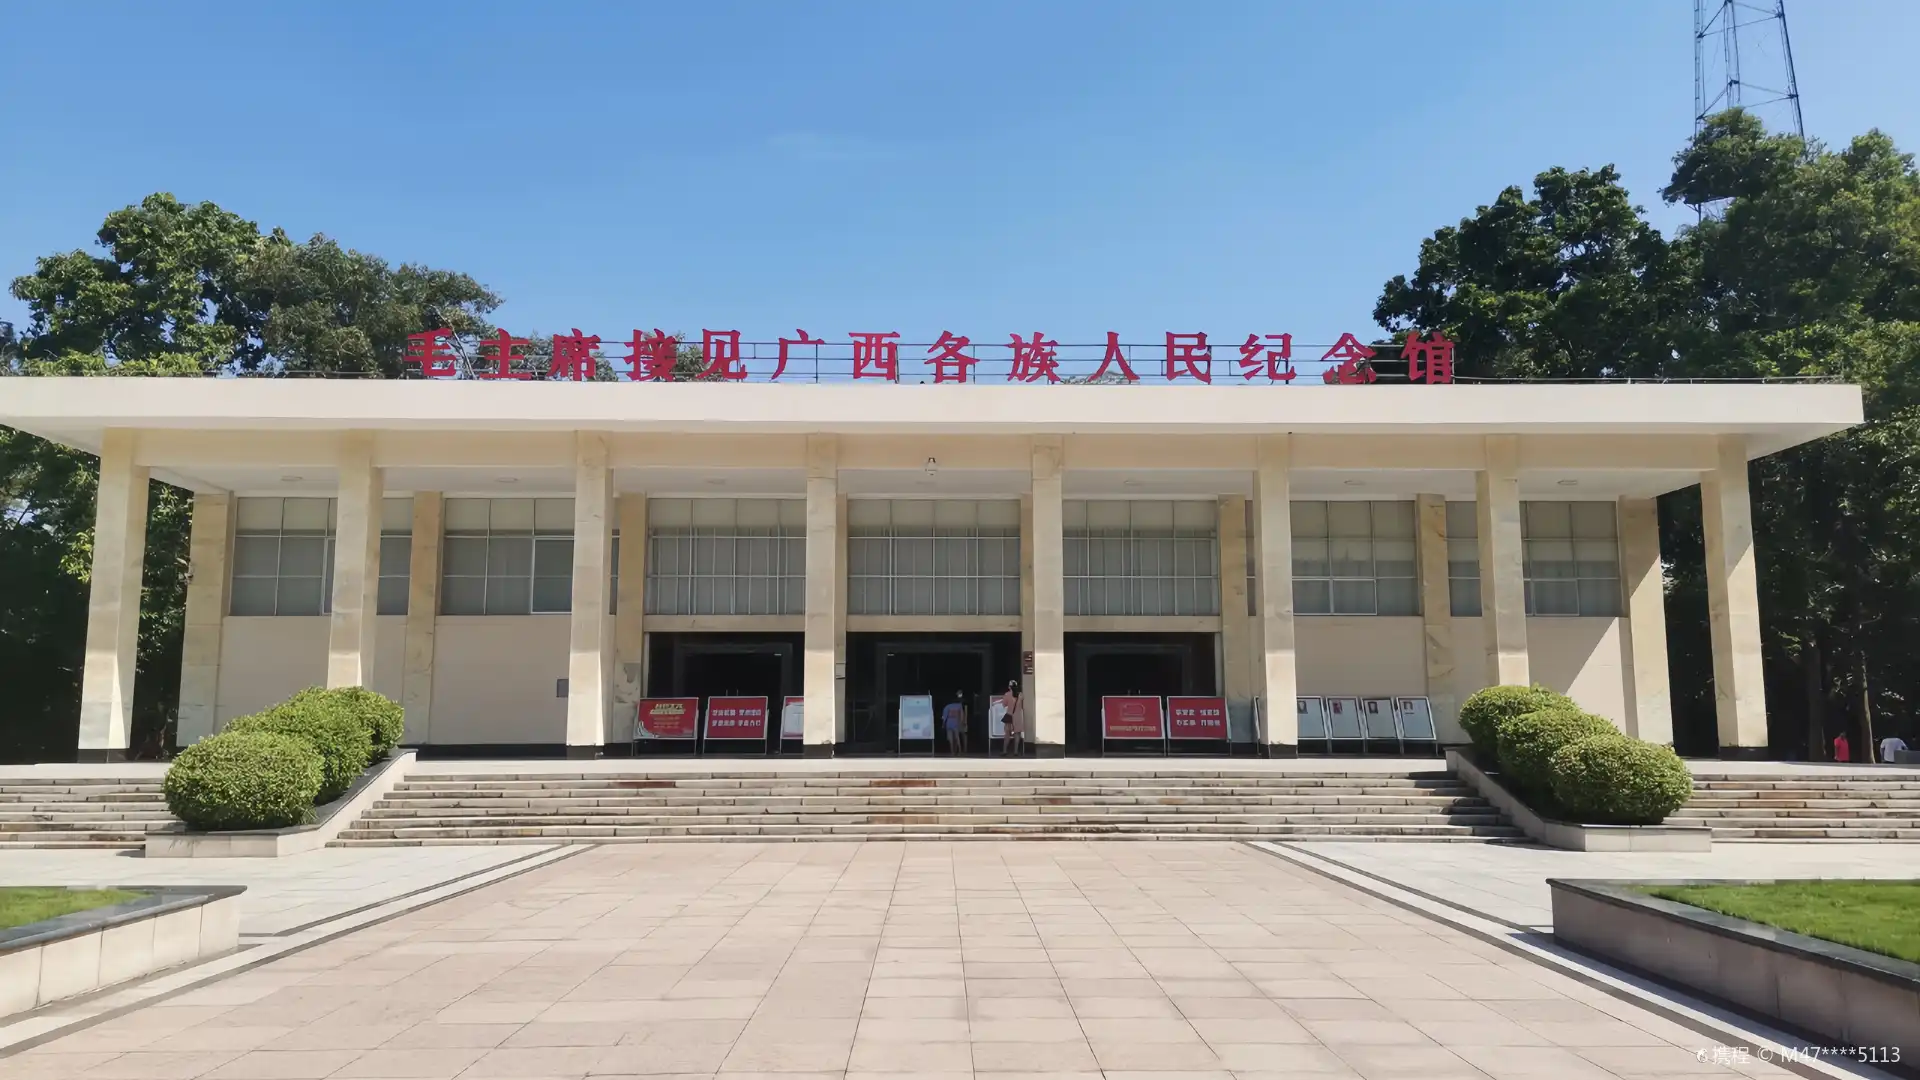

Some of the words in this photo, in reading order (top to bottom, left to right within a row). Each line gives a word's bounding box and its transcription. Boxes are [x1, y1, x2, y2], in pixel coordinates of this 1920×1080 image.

[404, 328, 1456, 385] 毛主席接见广西各族人民纪念馆
